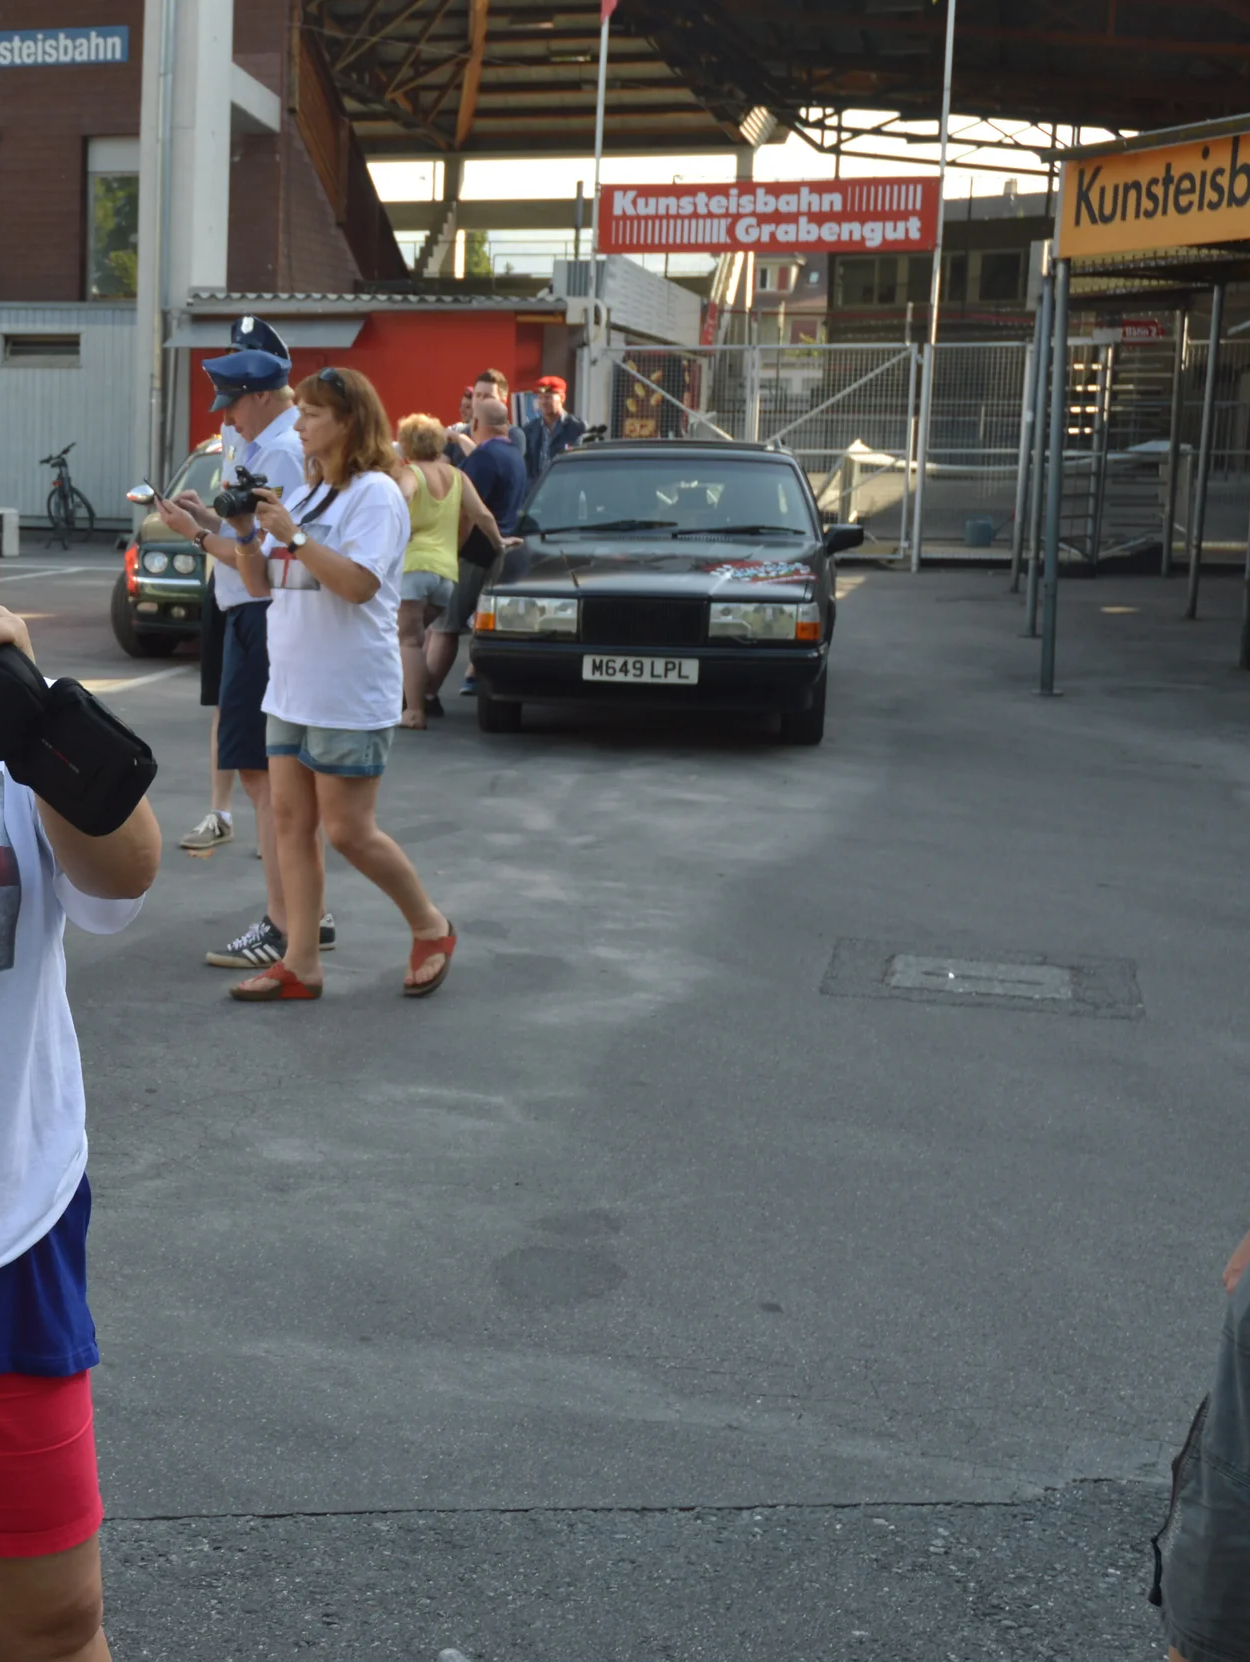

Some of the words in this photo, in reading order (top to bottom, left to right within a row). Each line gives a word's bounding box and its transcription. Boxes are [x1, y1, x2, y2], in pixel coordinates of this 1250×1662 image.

[1074, 136, 1250, 228] Kunsteisb
[612, 187, 843, 216] Kunsteisbahn
[735, 216, 921, 248] Grabengut
[591, 658, 644, 678] M649
[650, 660, 690, 680] LPL
